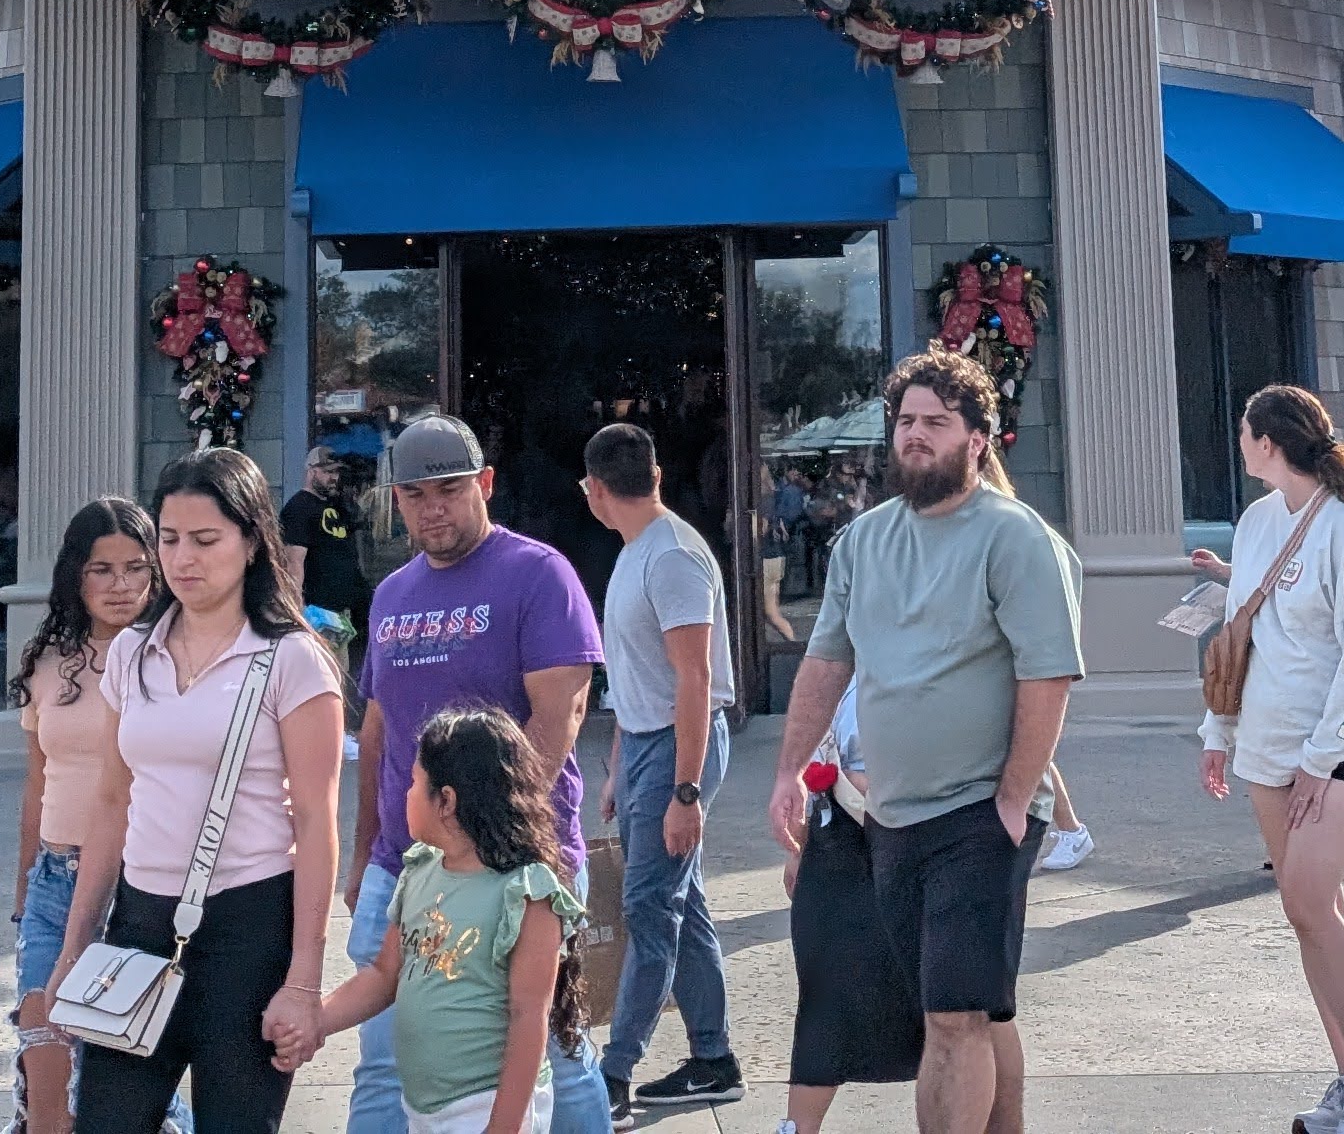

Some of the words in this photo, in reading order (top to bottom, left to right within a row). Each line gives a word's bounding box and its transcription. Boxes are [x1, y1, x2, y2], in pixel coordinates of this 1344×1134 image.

[376, 605, 490, 644] GUESS
[392, 658, 410, 667] LOS
[412, 653, 449, 666] ANGELES
[192, 806, 226, 878] LOVE
